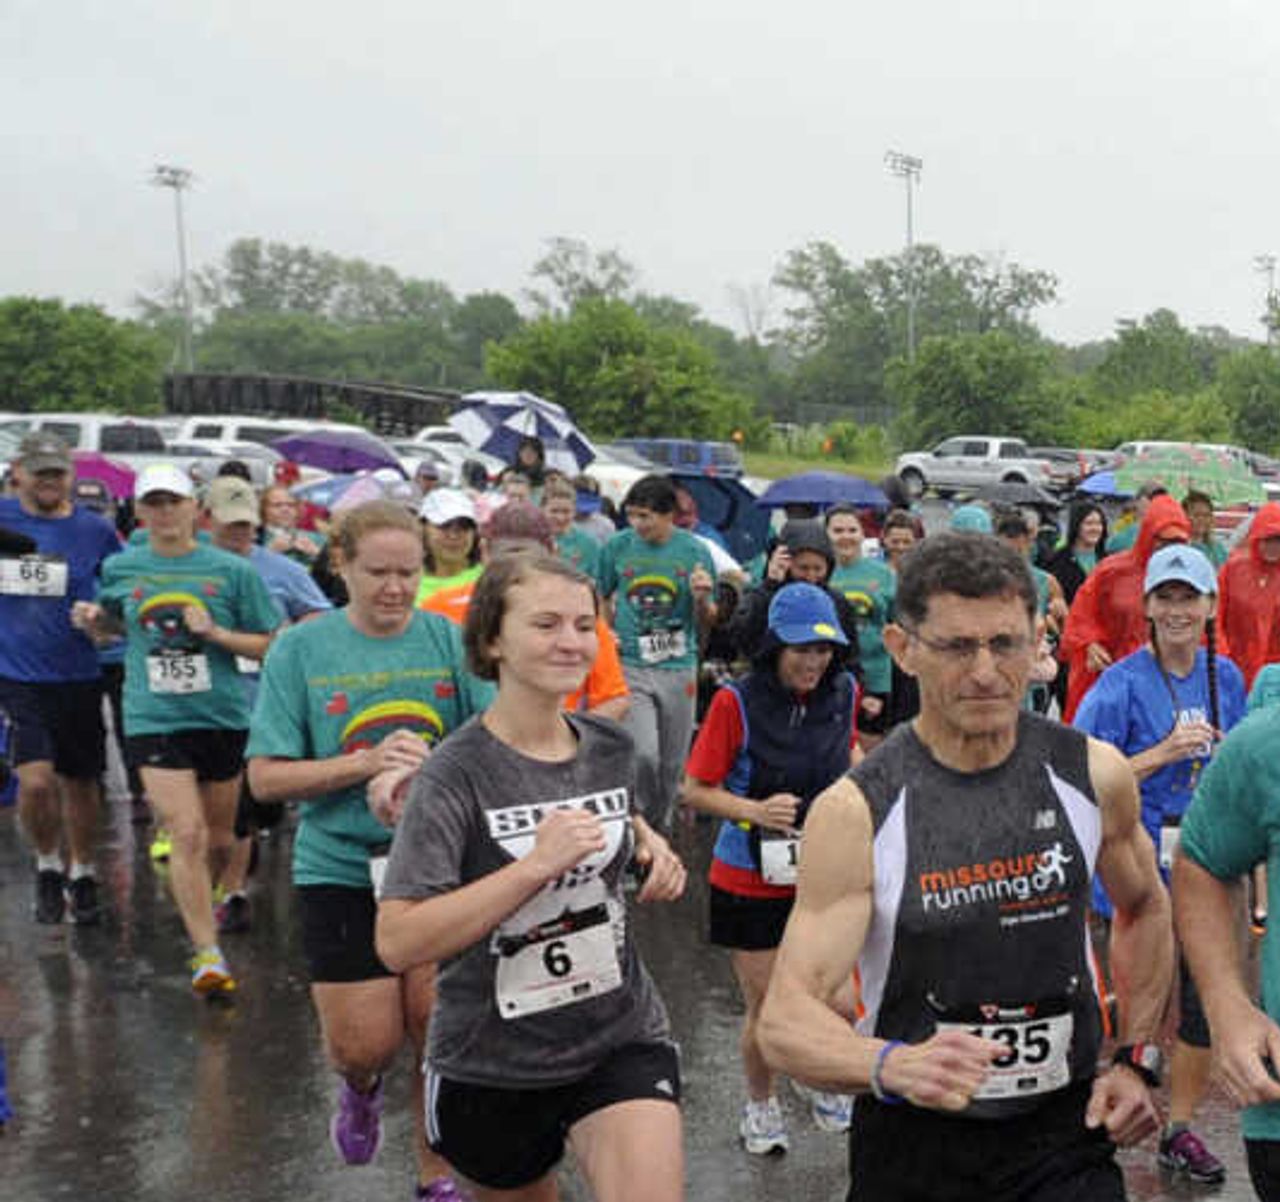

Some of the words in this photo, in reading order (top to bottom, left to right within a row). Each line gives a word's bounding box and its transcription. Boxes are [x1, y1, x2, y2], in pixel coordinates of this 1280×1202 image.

[922, 874, 1030, 912] running
[543, 940, 572, 978] 6
[970, 1022, 1050, 1068] 35
